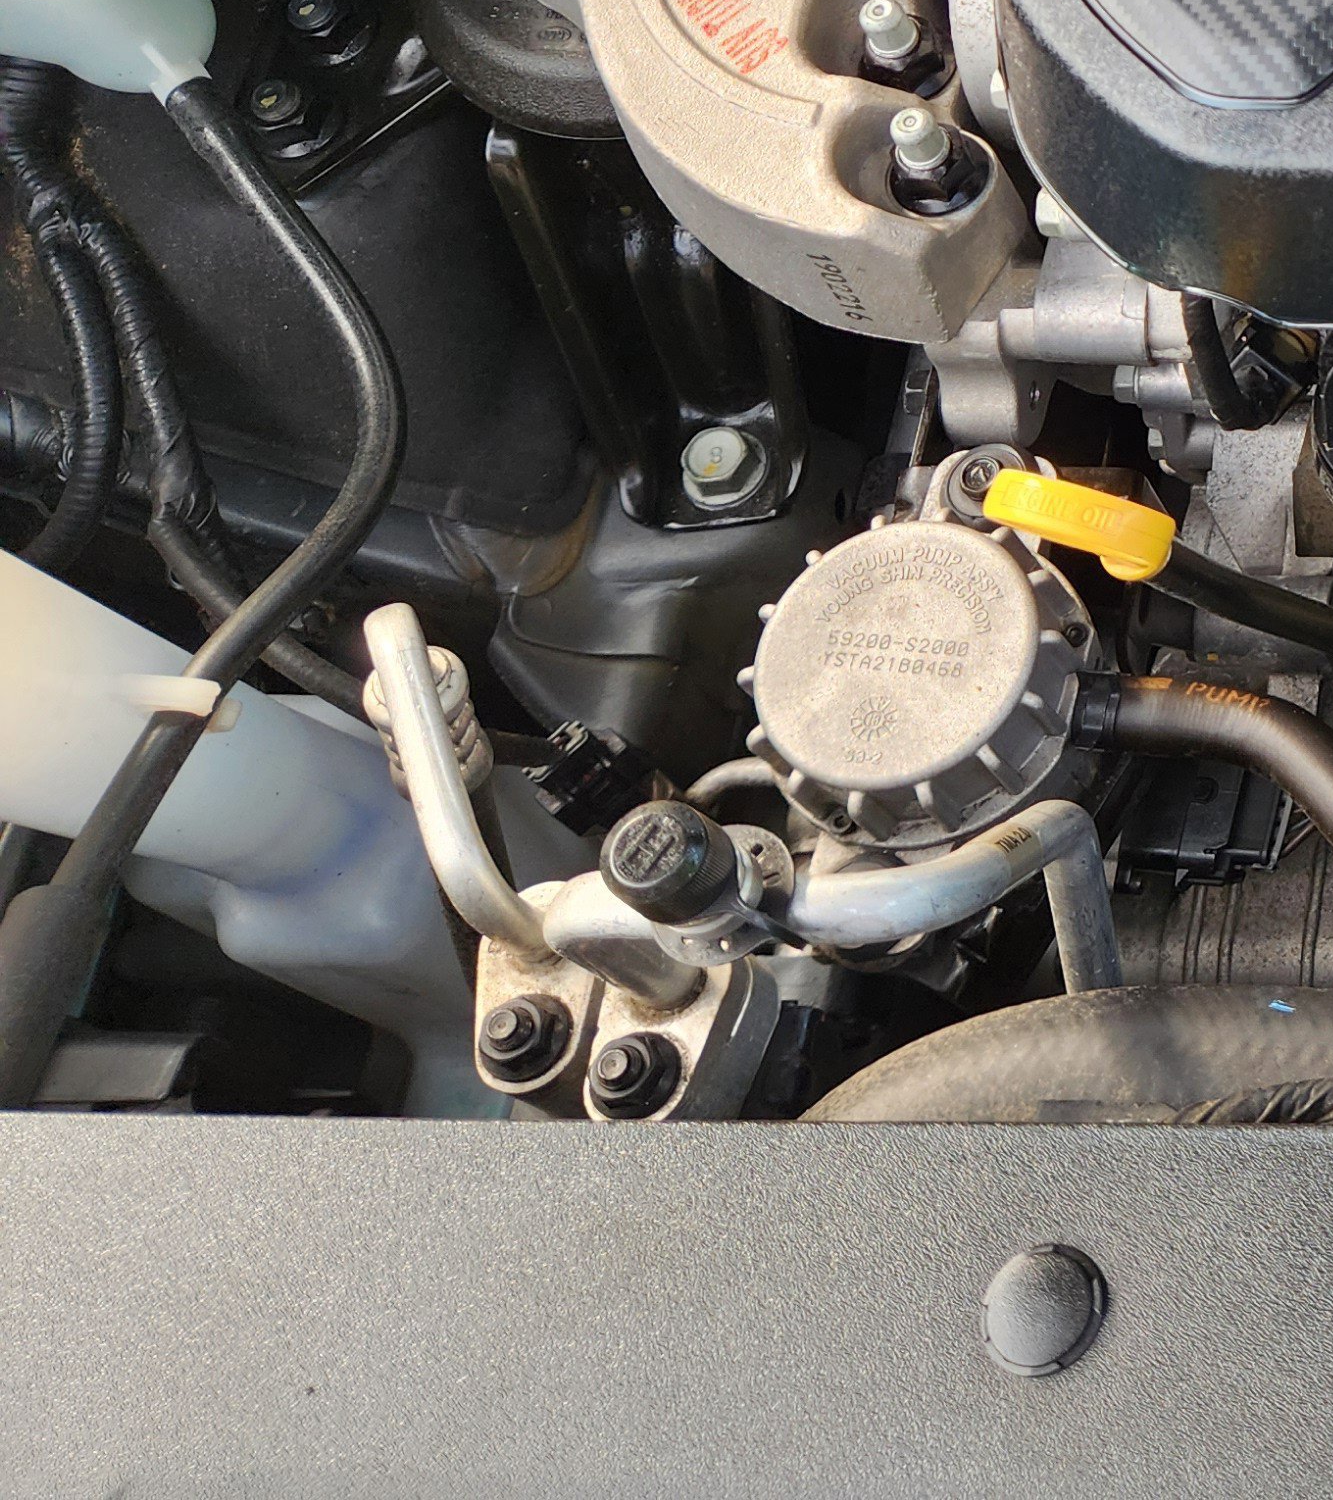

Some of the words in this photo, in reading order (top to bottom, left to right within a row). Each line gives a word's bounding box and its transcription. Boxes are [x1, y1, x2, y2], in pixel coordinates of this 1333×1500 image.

[825, 547, 904, 590] VACUUM
[912, 547, 963, 568] PUMP
[815, 578, 874, 623] YOUNG
[880, 565, 924, 585] SHIN
[927, 568, 992, 634] PRECISION
[828, 630, 970, 657] 59200-S2000
[1186, 681, 1271, 712] PUMP
